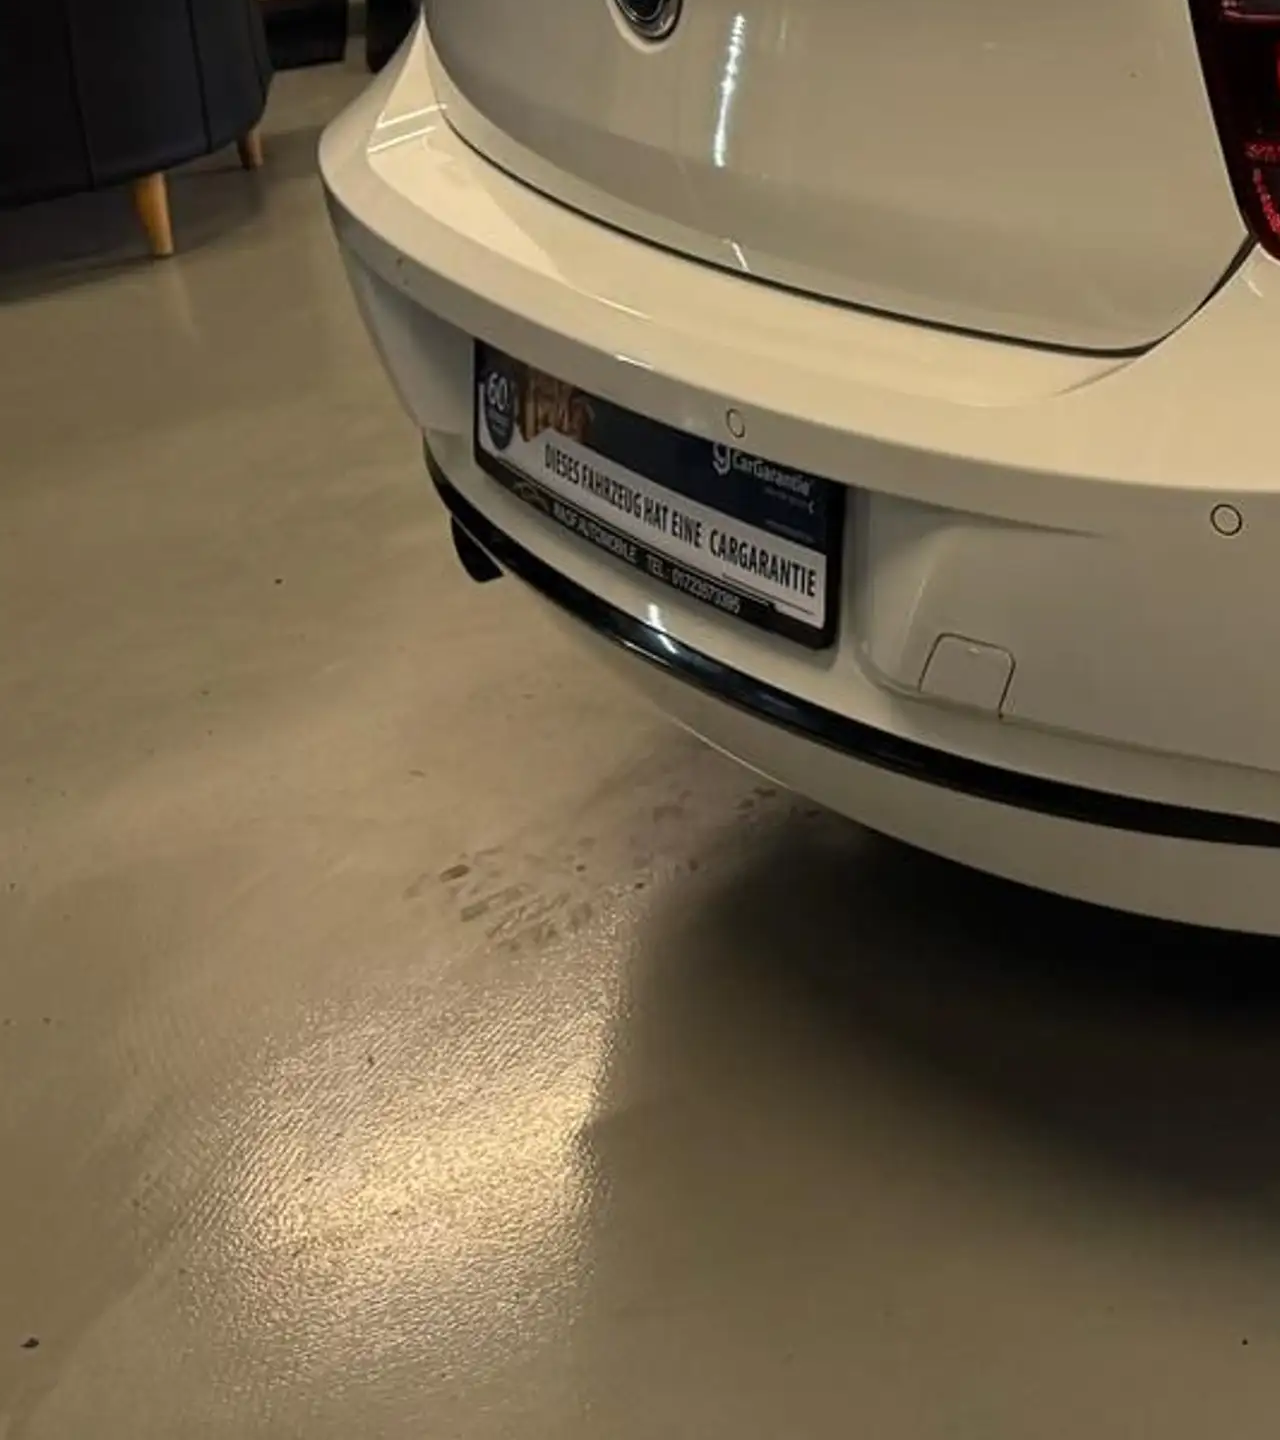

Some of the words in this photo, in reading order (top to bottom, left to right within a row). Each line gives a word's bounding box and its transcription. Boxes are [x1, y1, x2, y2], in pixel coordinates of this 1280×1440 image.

[545, 443, 579, 484] DIESES
[582, 463, 641, 519] FAHRZEUG
[643, 496, 668, 533] HAT
[672, 511, 702, 548] EINE
[709, 528, 817, 598] CARGARANTIE
